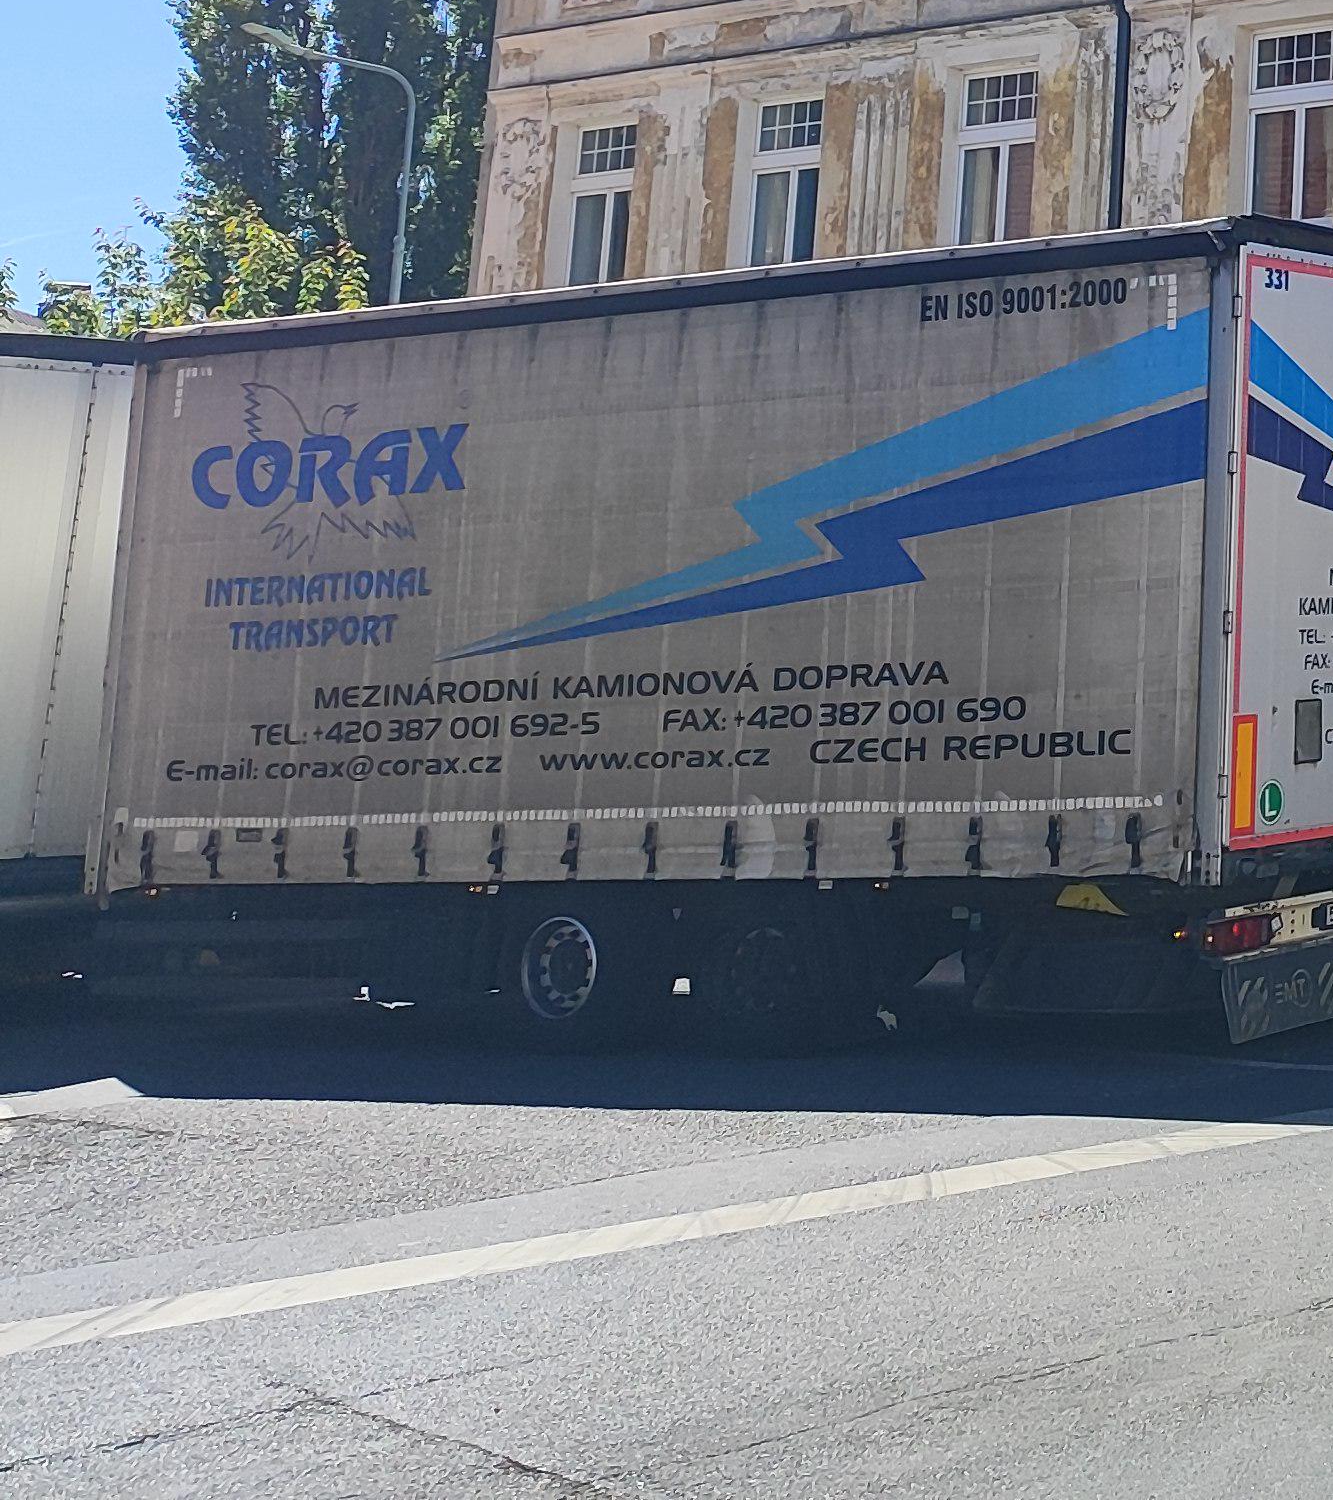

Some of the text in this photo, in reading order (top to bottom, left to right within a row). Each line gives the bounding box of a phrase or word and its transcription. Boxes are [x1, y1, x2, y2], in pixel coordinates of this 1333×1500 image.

[921, 277, 1128, 322] EN ISO 9001:2000
[1264, 268, 1289, 291] 331
[191, 423, 469, 510] CORAX
[204, 566, 432, 608] INTERNATIONAL
[229, 613, 399, 652] TRANSPORT
[314, 661, 949, 710] MEZINÁRODNÍ KAMIONOVÁ DOPRAVA
[314, 720, 382, 744] +420
[387, 718, 442, 742] 387
[450, 715, 499, 740] 001
[510, 711, 601, 738] 692-5
[662, 708, 726, 732] FAX:
[734, 704, 813, 730] +420
[818, 701, 881, 727] 387
[889, 699, 945, 725] 001
[956, 696, 1027, 723] 690
[166, 729, 1132, 781] E-mail: corax@corax.cz www.corax.cz CZECH REPUBLIC
[1264, 787, 1277, 817] L
